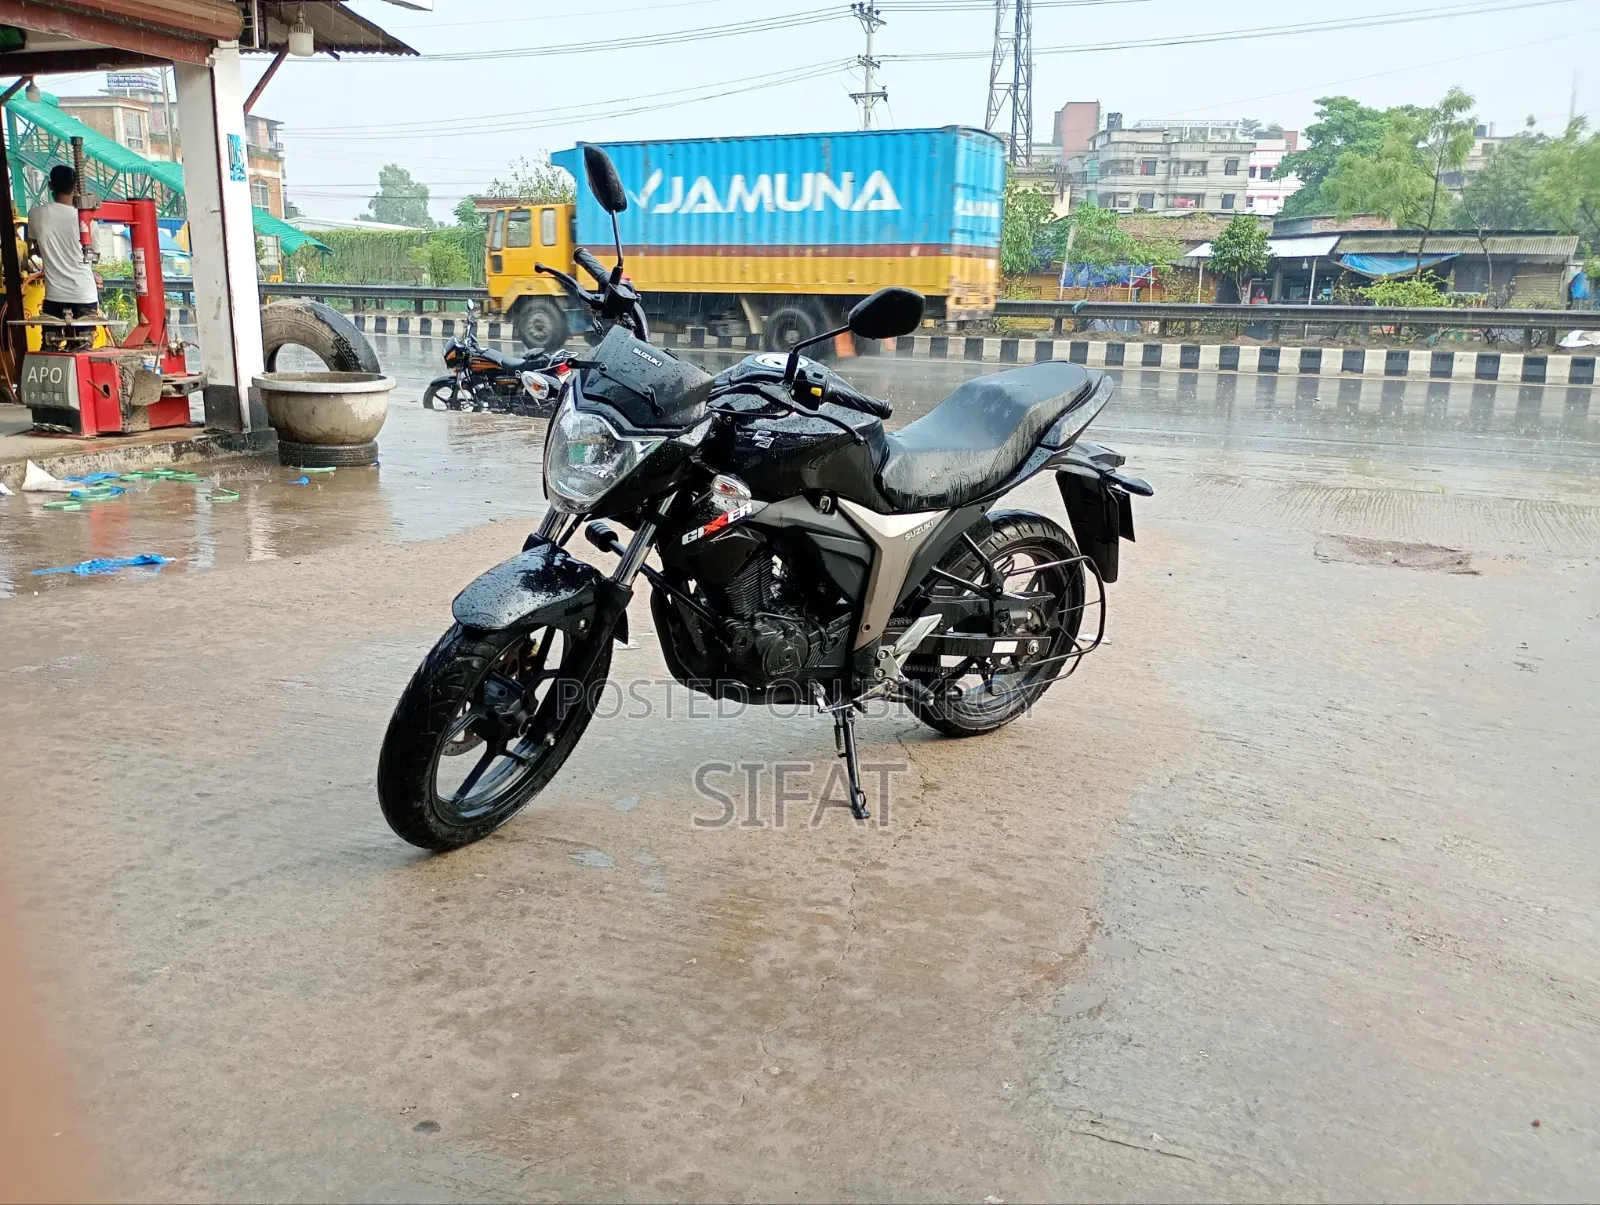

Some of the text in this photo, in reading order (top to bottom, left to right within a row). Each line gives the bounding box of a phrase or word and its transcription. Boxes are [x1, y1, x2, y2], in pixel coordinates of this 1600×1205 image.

[652, 169, 902, 214] JAMUNA
[632, 347, 663, 367] SUZUKI
[27, 366, 63, 384] APO
[681, 502, 753, 546] GIXXER
[904, 520, 934, 541] SUZUKI
